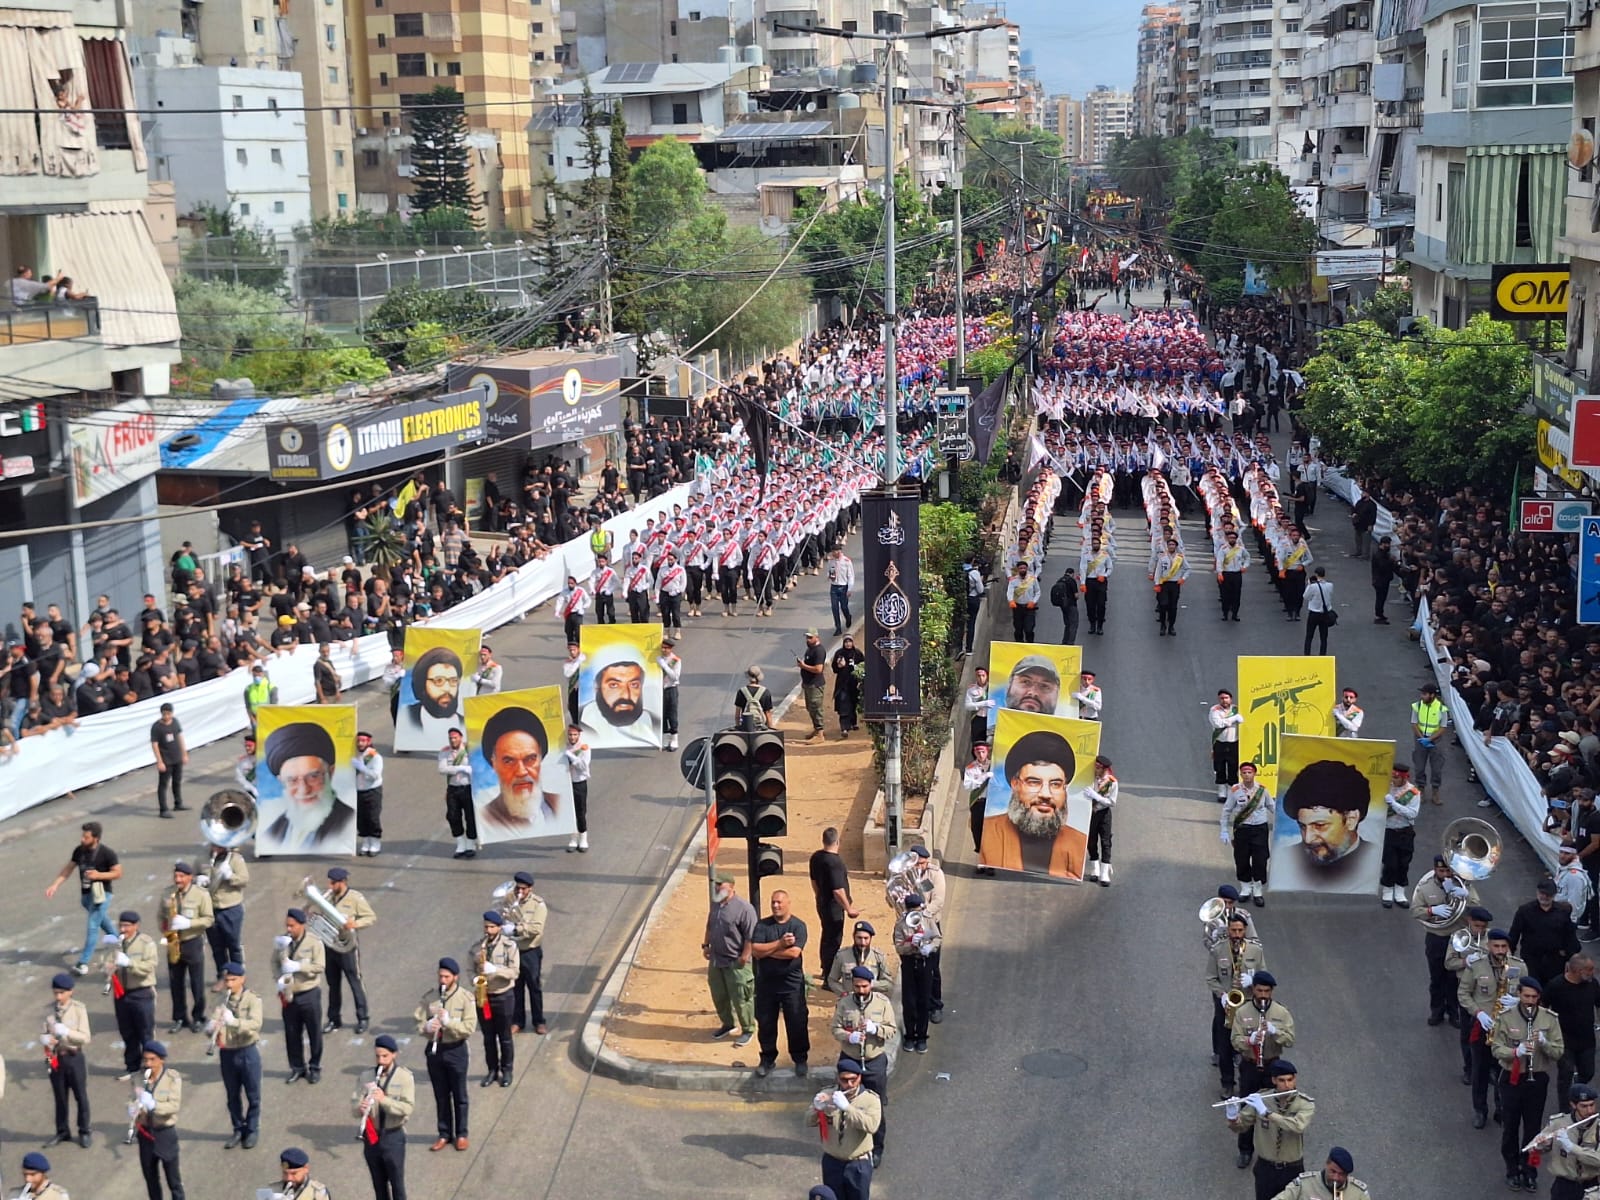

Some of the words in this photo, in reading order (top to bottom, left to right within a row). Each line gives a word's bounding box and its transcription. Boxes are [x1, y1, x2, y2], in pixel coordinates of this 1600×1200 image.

[1511, 280, 1569, 305] OM
[113, 411, 156, 456] FRIGO
[357, 418, 401, 455] ITAOUI
[403, 400, 481, 444] ELECTRONICS
[277, 454, 310, 467] ITAOUI
[1524, 513, 1544, 525] alfa
